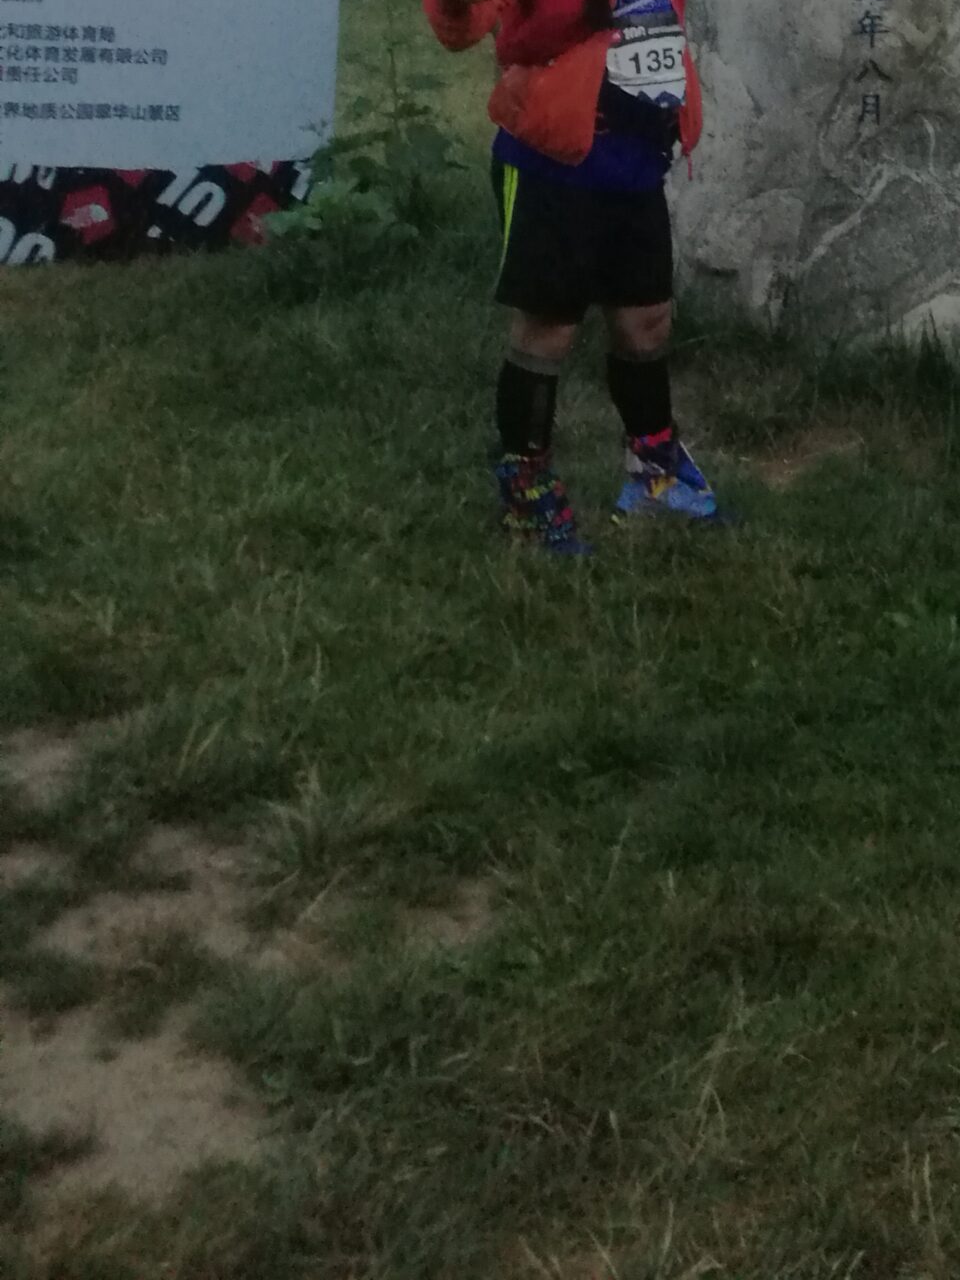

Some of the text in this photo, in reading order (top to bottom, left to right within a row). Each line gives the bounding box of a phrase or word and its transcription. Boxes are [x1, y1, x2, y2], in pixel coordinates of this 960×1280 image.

[0, 45, 168, 65] 化体育发展有限公司
[0, 65, 78, 84] 责任公司
[0, 102, 181, 121] 界地质公园翠华山景区
